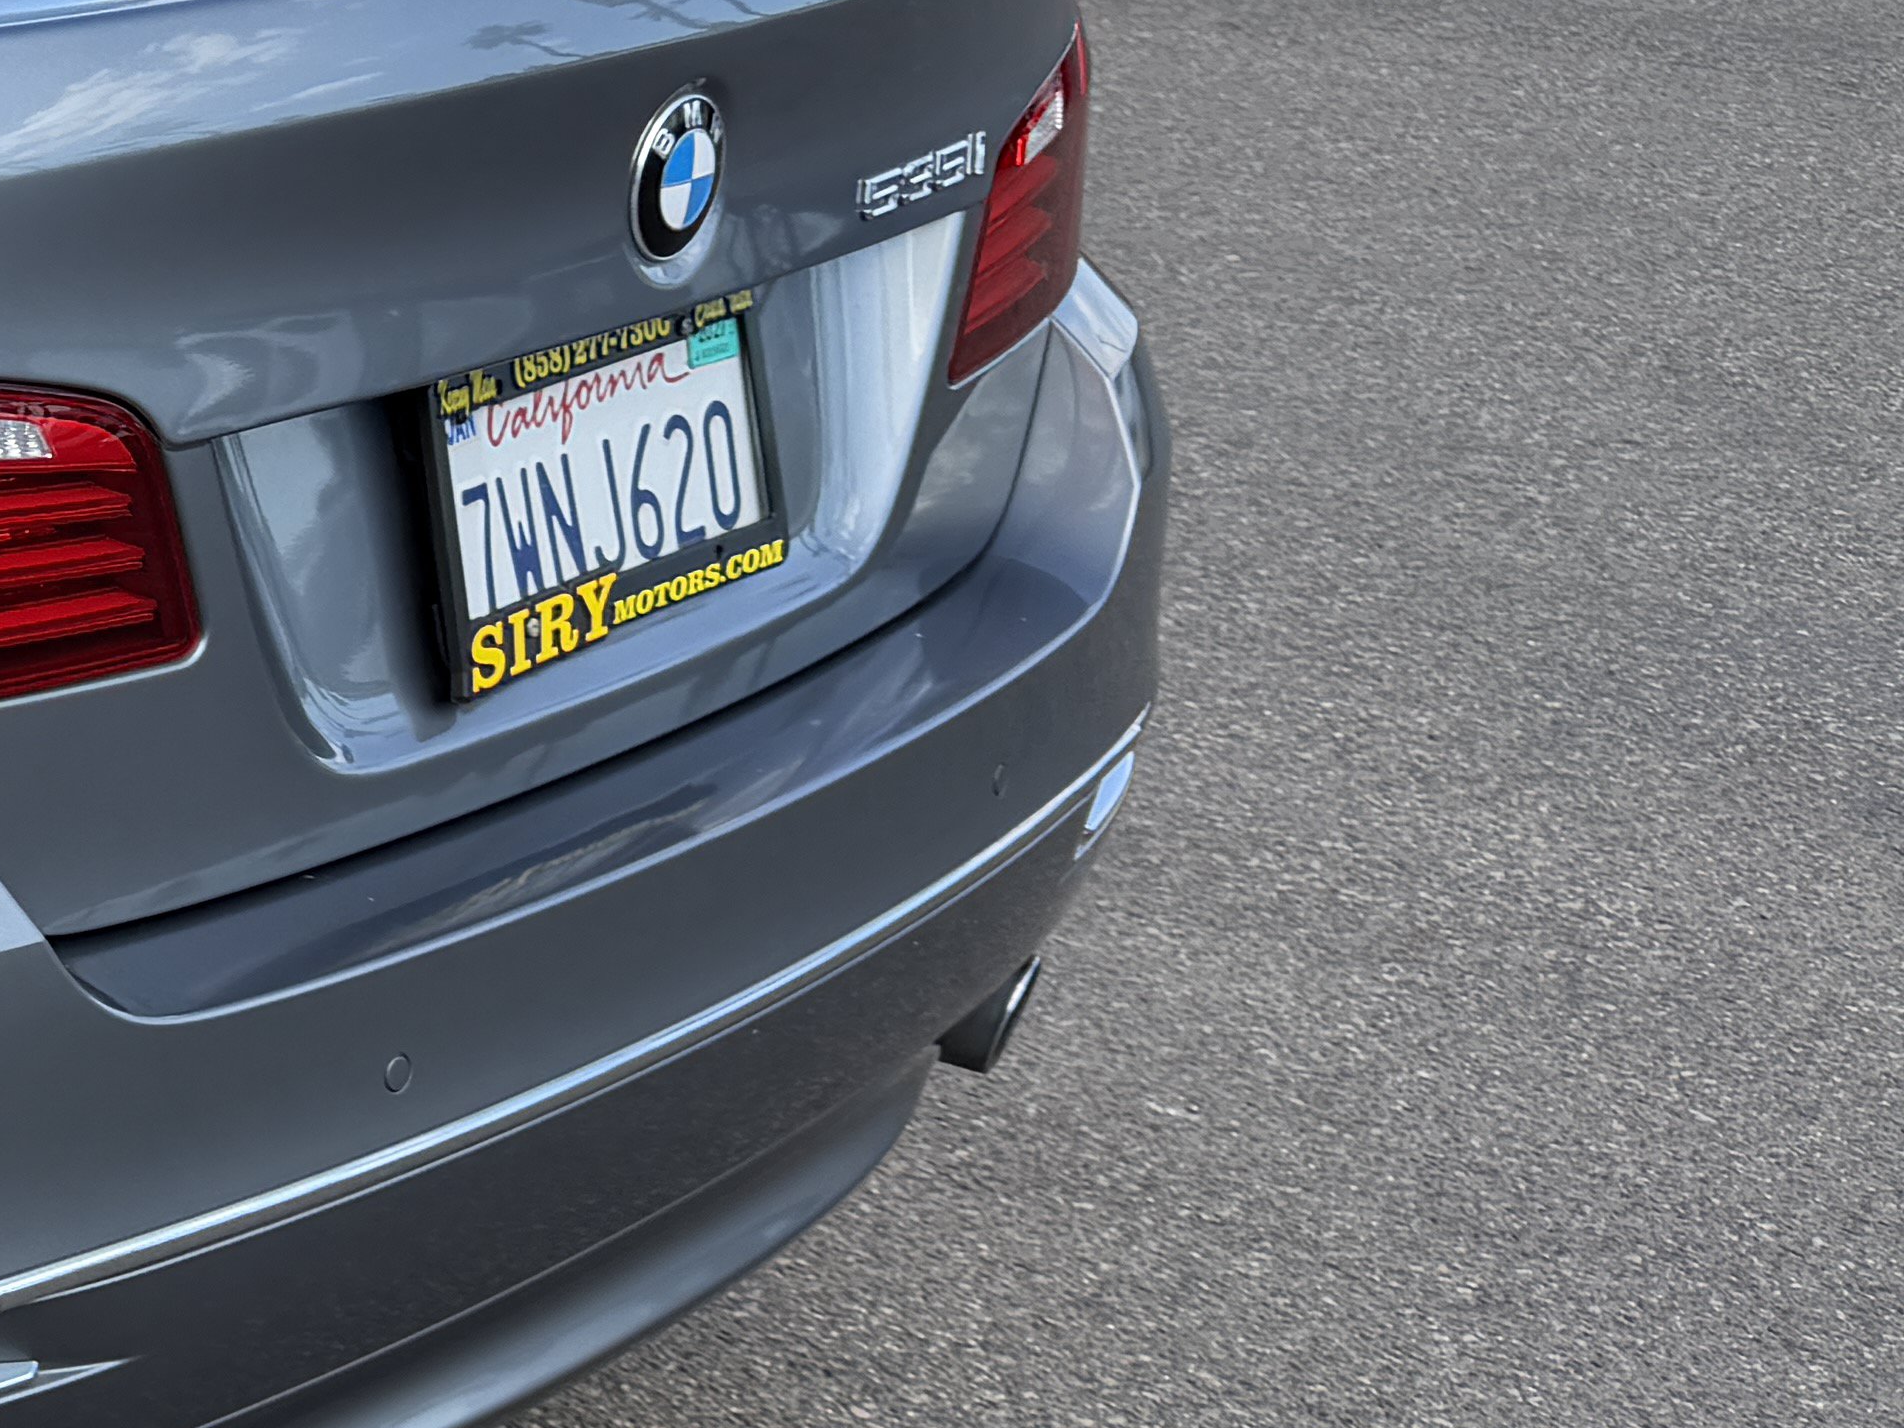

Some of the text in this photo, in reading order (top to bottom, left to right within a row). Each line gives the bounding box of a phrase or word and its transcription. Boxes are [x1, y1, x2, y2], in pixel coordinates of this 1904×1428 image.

[486, 351, 690, 448] California
[461, 400, 743, 619] 7WNJ620
[471, 539, 785, 694] SIRY MOTORS.COM
